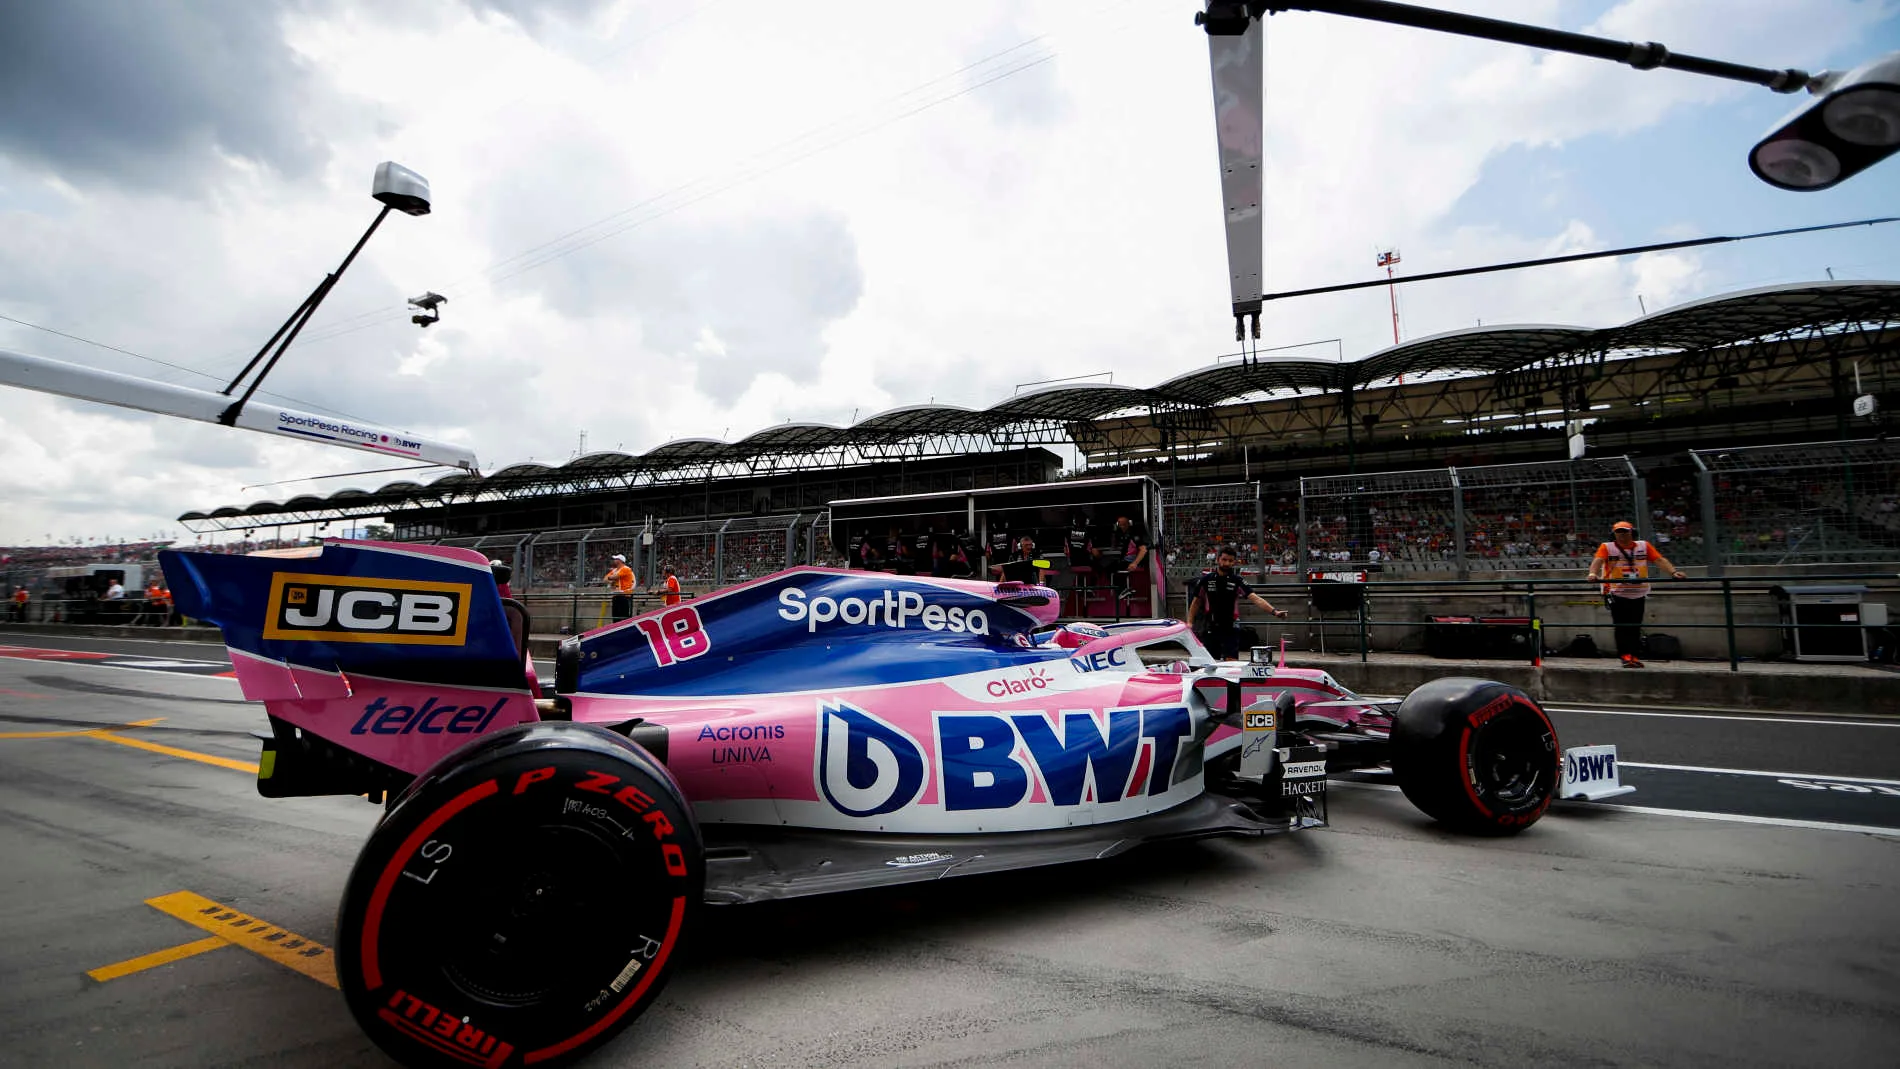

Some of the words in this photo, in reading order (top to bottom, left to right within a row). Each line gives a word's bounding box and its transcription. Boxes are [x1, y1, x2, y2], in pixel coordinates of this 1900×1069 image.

[279, 412, 338, 432] SportPesa
[341, 424, 378, 442] Racing
[285, 589, 453, 632] JCB
[778, 587, 989, 636] SportPesa
[635, 604, 711, 667] 18
[1071, 647, 1126, 673] NEC
[1252, 667, 1272, 677] NEC
[987, 676, 1047, 697] Claro
[350, 698, 509, 735] telcel
[1247, 714, 1274, 727] JCB
[697, 724, 785, 742] Acronis
[712, 747, 772, 763] UNIVA
[935, 707, 1193, 811] BWT
[1579, 754, 1615, 782] BWT
[1287, 765, 1323, 774] RAVENOL
[1282, 780, 1326, 796] HACKETT
[512, 767, 557, 795] P
[574, 770, 687, 876] ZERO
[403, 840, 452, 884] LS
[630, 935, 661, 959] R
[378, 989, 514, 1069] PIRELLI
